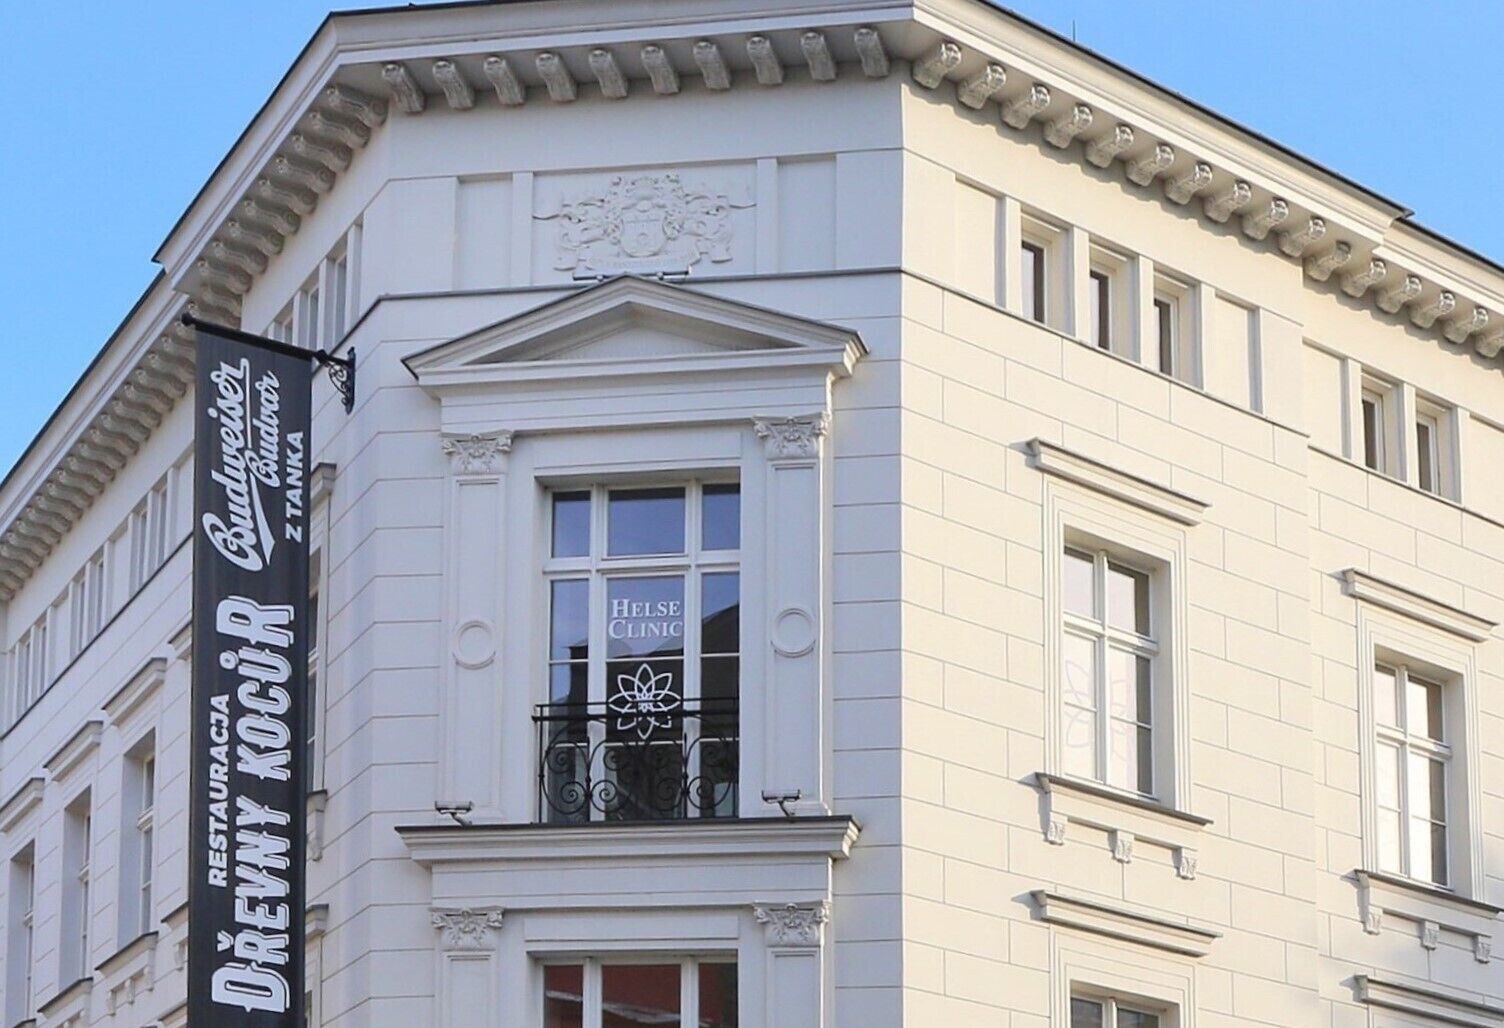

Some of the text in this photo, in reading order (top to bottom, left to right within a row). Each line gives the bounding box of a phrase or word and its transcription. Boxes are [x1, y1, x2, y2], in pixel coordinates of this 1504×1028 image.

[202, 357, 270, 571] Budweiser
[244, 370, 280, 488] Budvar
[286, 431, 303, 542] Z TANKA
[216, 595, 294, 781] KOCŮR
[208, 694, 230, 887] RESTAURACJA
